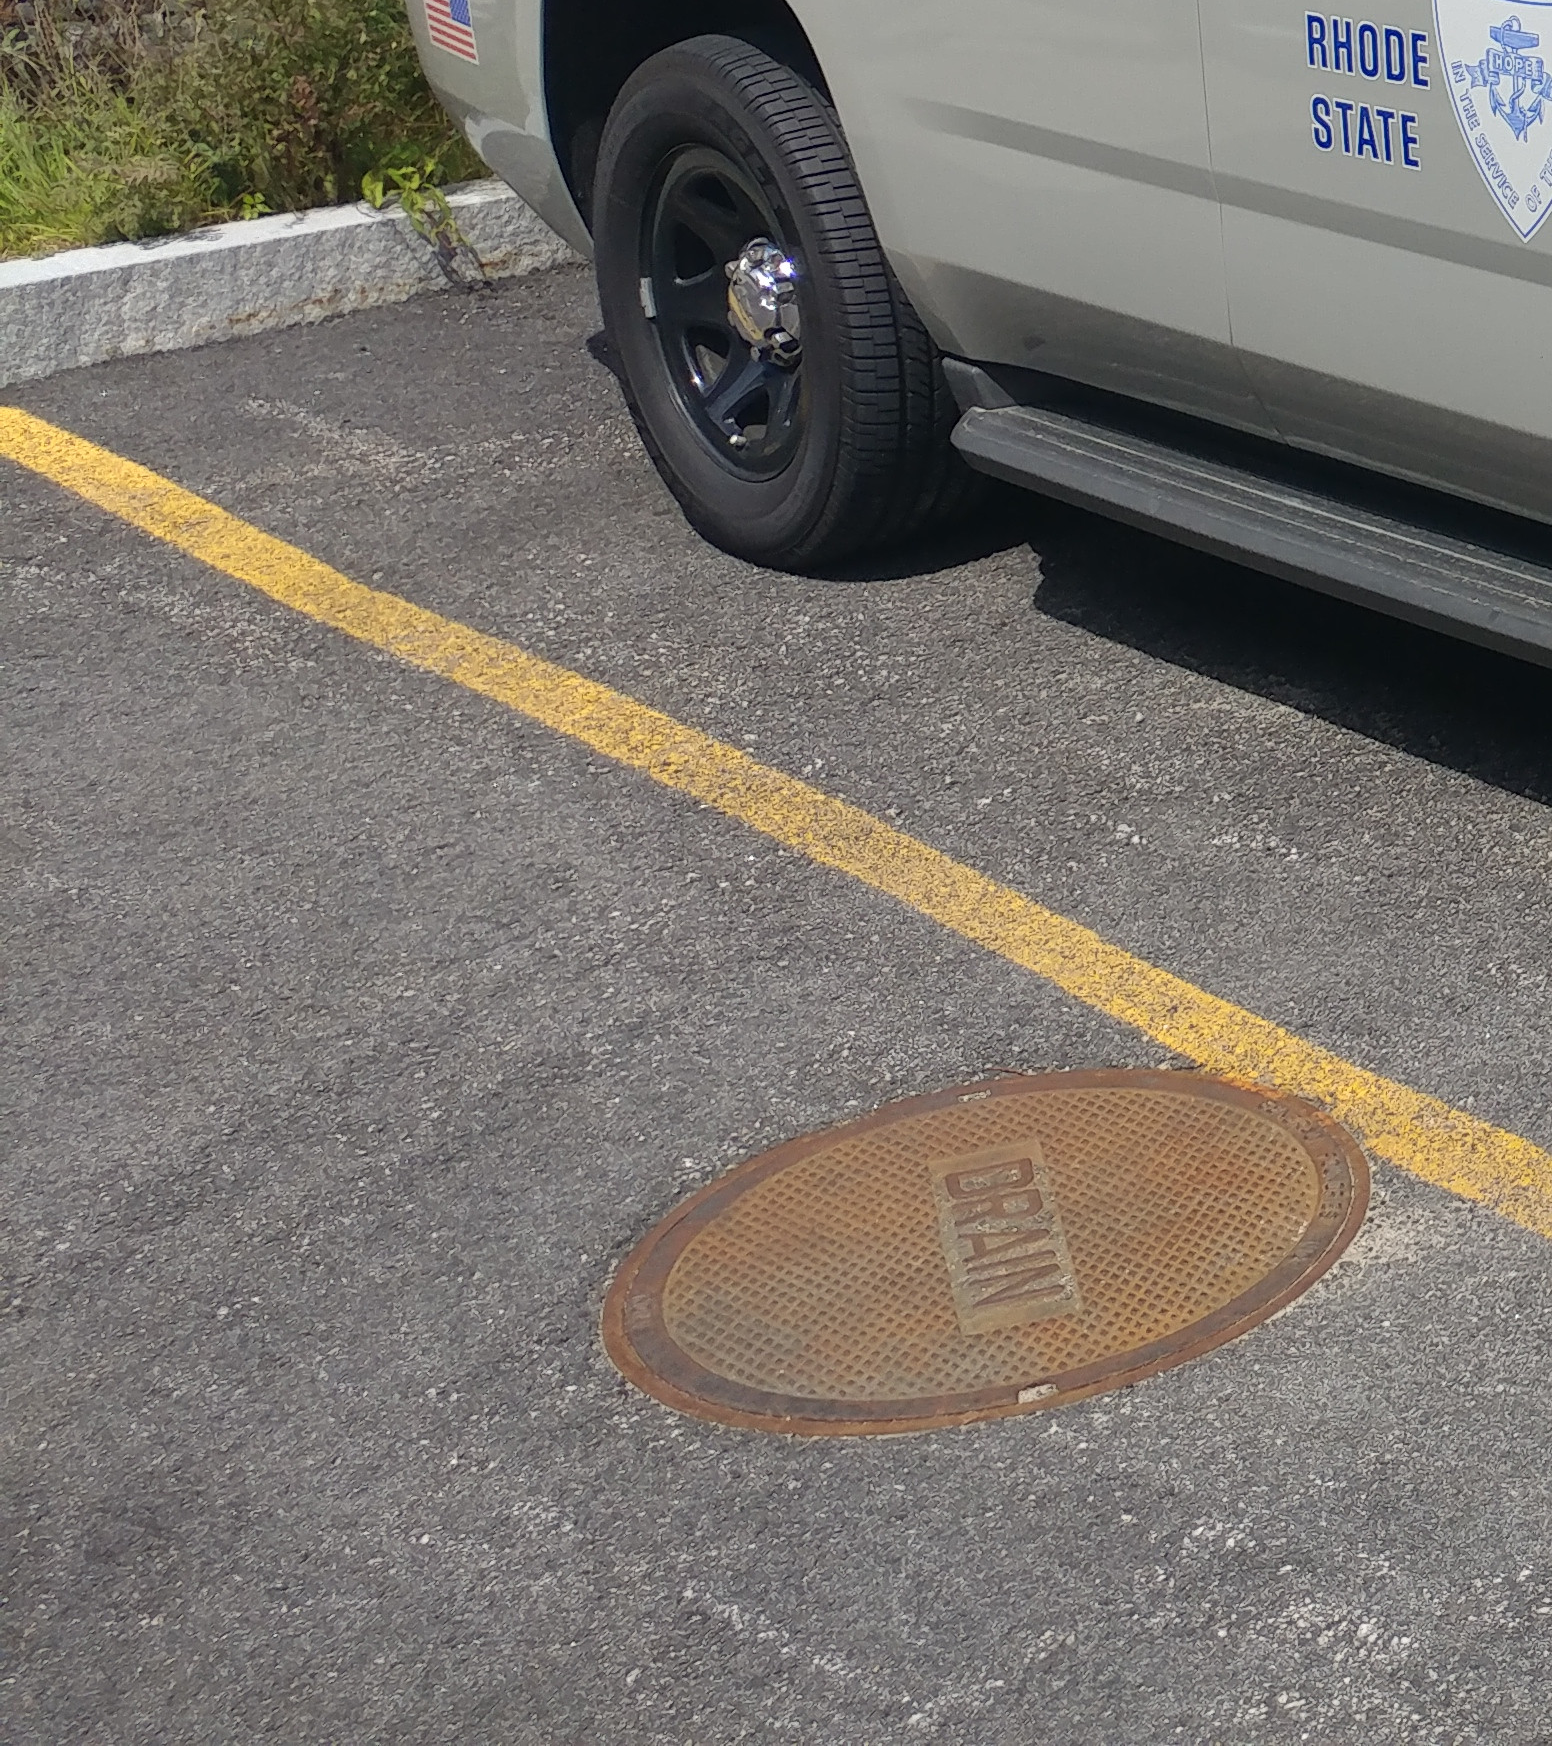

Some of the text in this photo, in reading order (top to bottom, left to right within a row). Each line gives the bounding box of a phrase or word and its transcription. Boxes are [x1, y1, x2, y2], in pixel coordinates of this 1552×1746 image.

[1305, 14, 1429, 87] RHODE
[1495, 54, 1534, 76] HOPE
[1309, 96, 1419, 168] STATE
[1451, 59, 1467, 84] IN
[1459, 87, 1481, 132] THE
[1475, 132, 1520, 210] SERVICE
[1524, 184, 1543, 213] OF
[944, 1156, 1066, 1309] DRAIN
